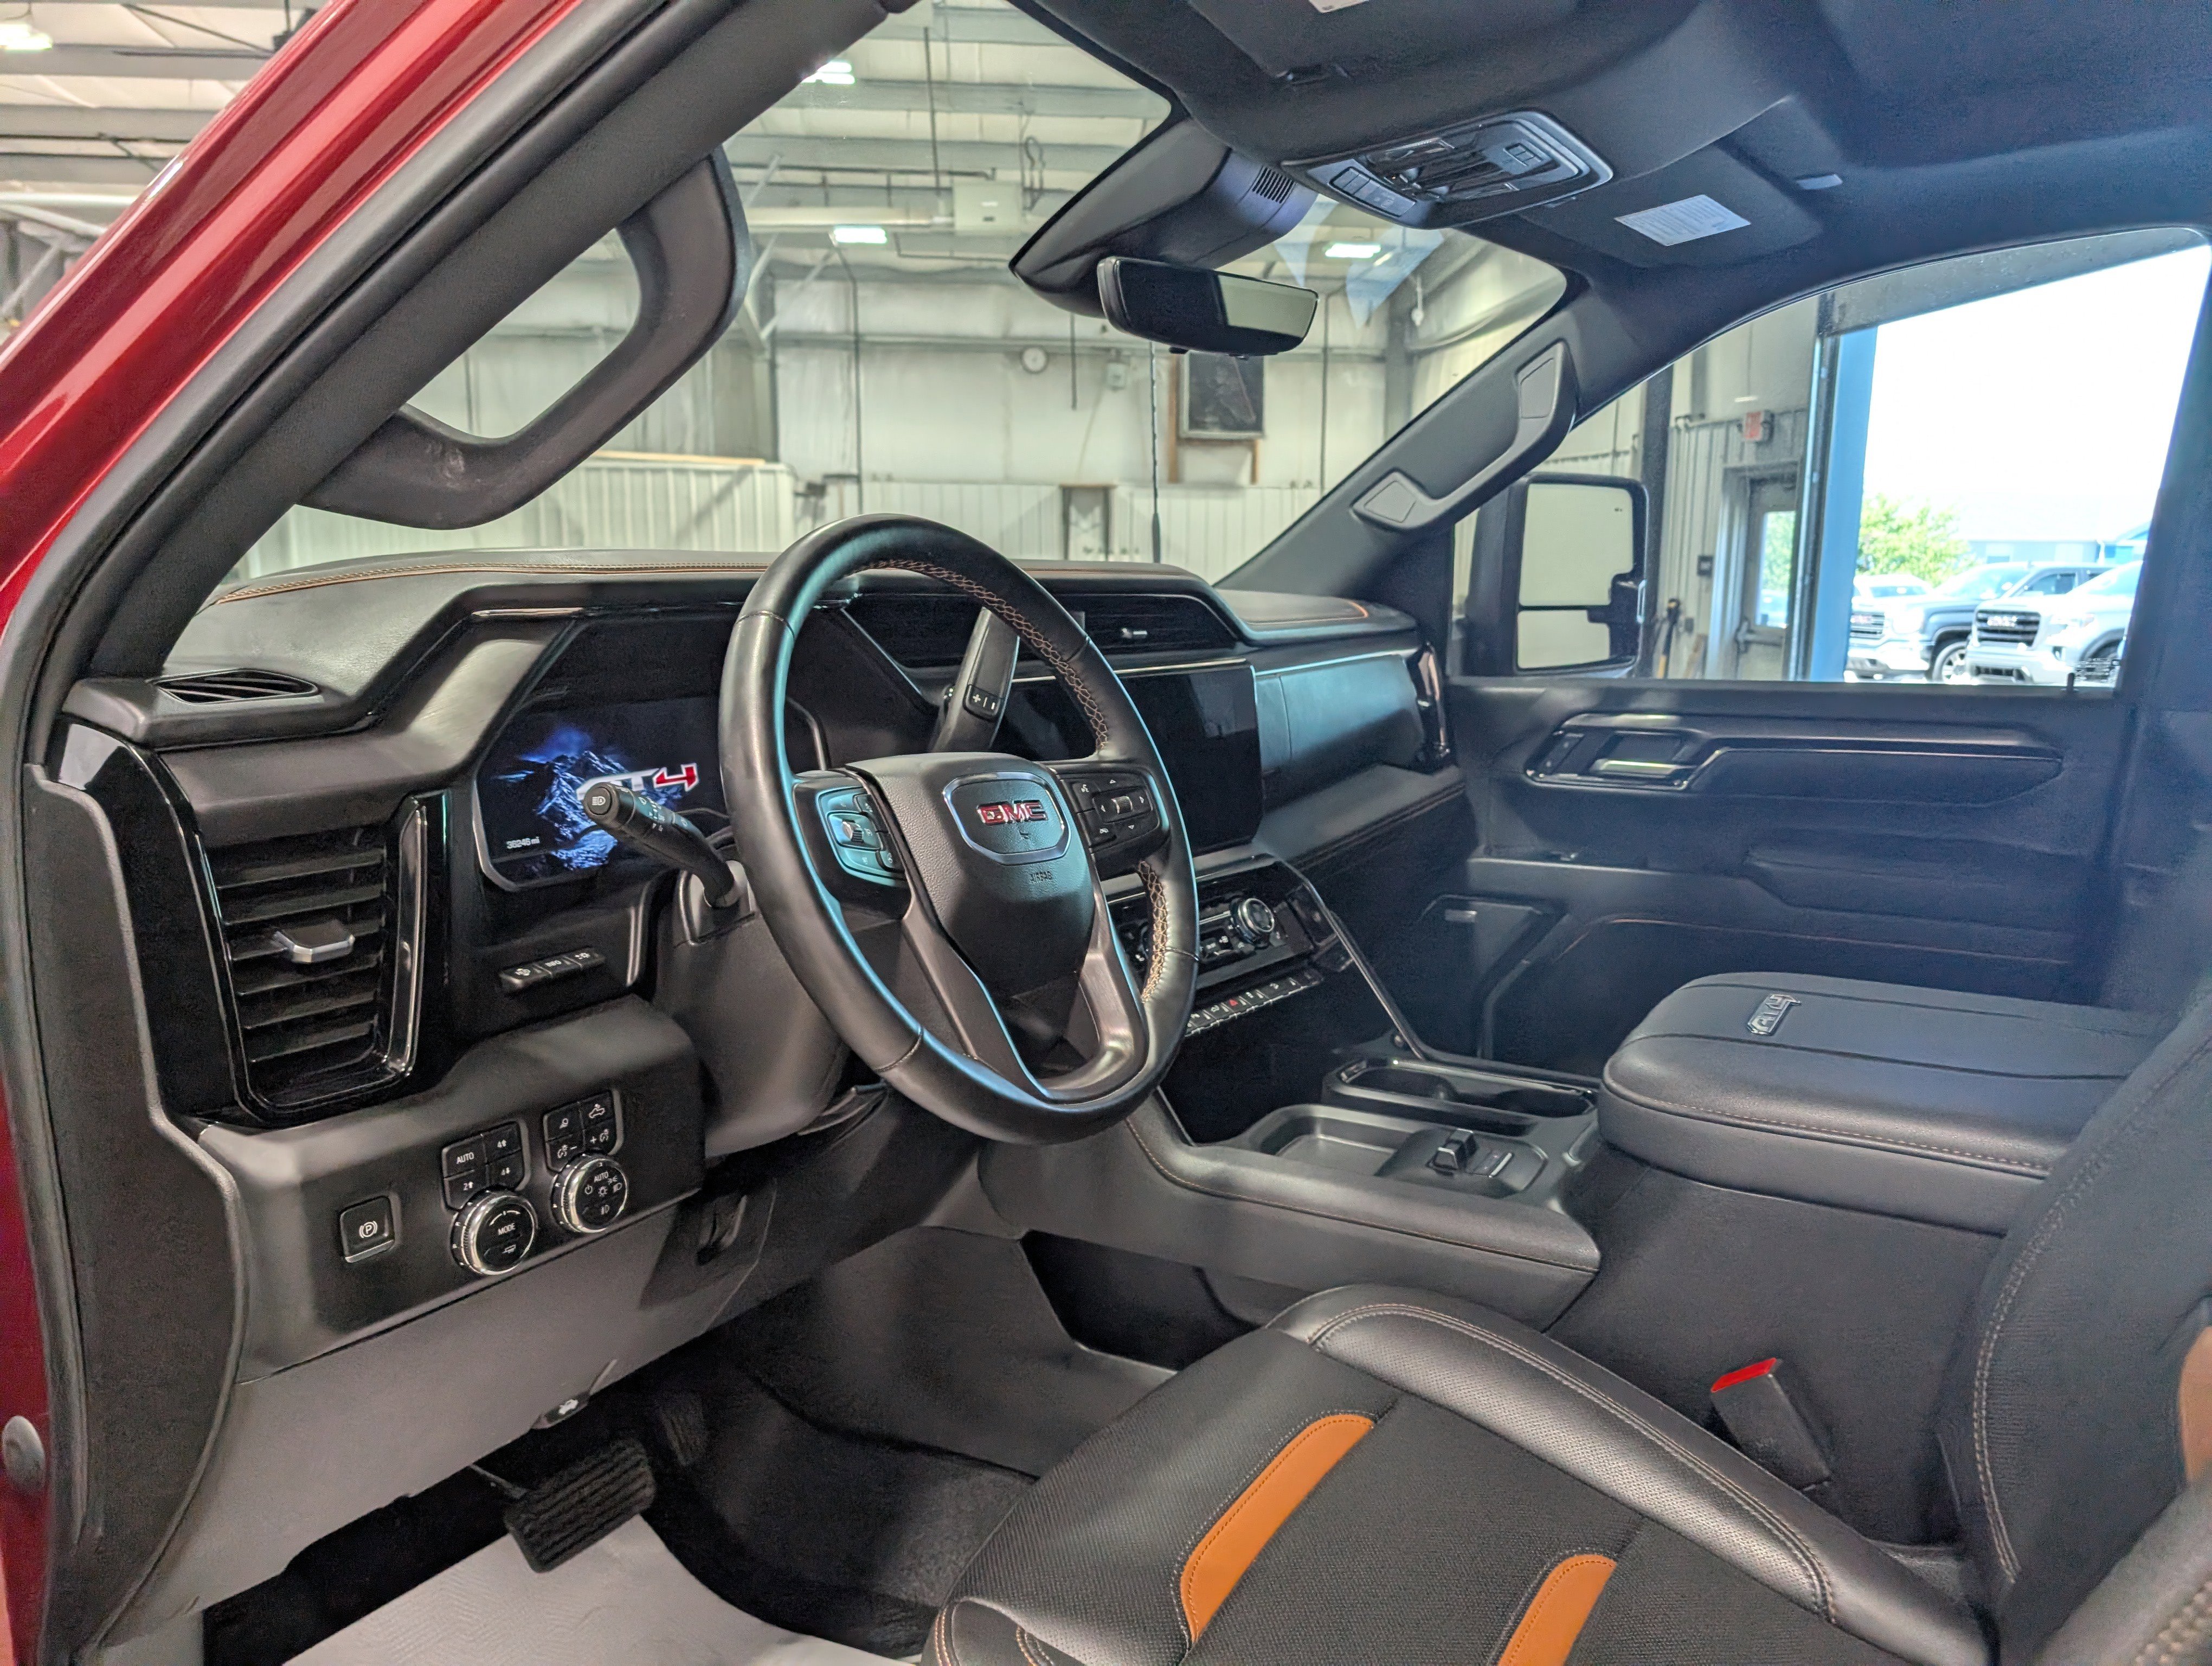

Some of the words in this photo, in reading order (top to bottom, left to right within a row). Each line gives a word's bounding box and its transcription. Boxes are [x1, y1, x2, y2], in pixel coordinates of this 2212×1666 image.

[977, 799, 1049, 826] GMC
[456, 1151, 474, 1164] AUTO
[594, 1171, 609, 1182] AUTO
[498, 1222, 516, 1235] MODE
